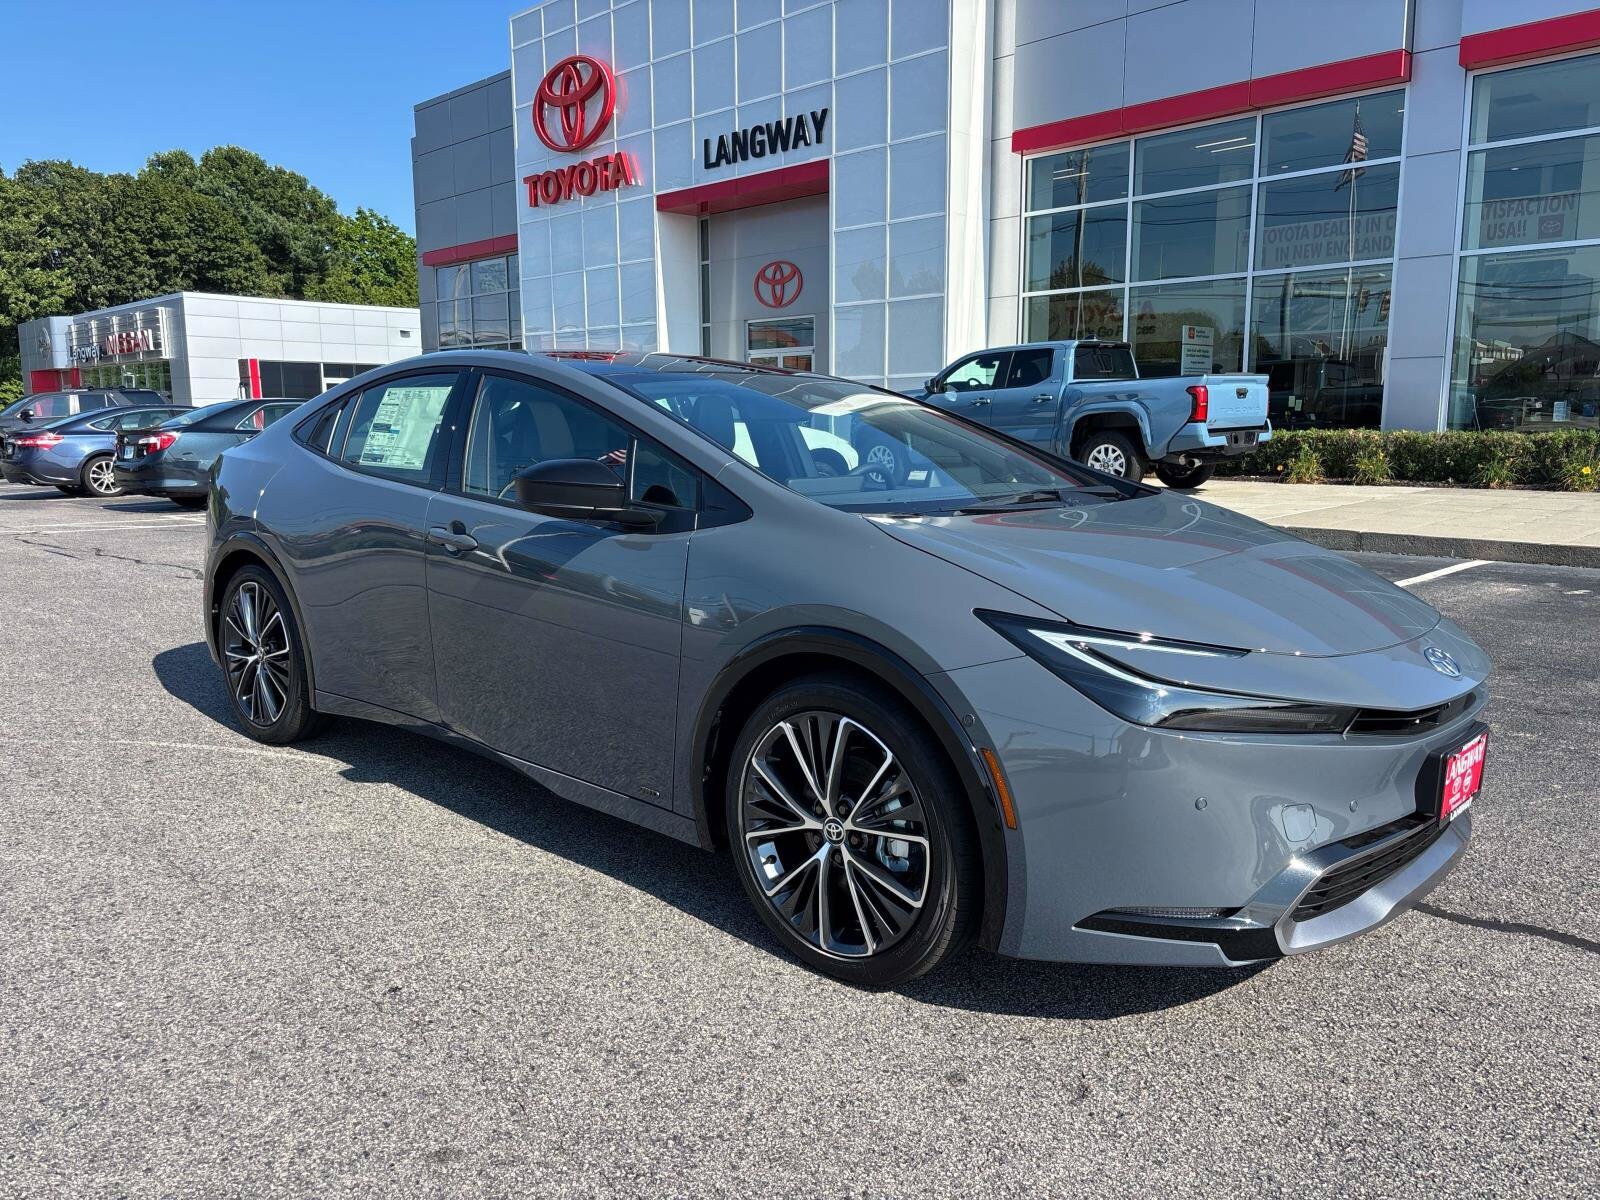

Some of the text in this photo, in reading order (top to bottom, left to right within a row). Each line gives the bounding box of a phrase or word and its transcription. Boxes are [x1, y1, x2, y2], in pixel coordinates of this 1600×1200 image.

[703, 107, 829, 170] LANGWAY
[522, 151, 633, 208] TOYOTA
[1486, 219, 1527, 240] USA!!
[1275, 245, 1290, 262] IN
[1293, 241, 1323, 260] NEW
[106, 329, 154, 355] NISSAN
[1445, 741, 1486, 786] LANGWAY
